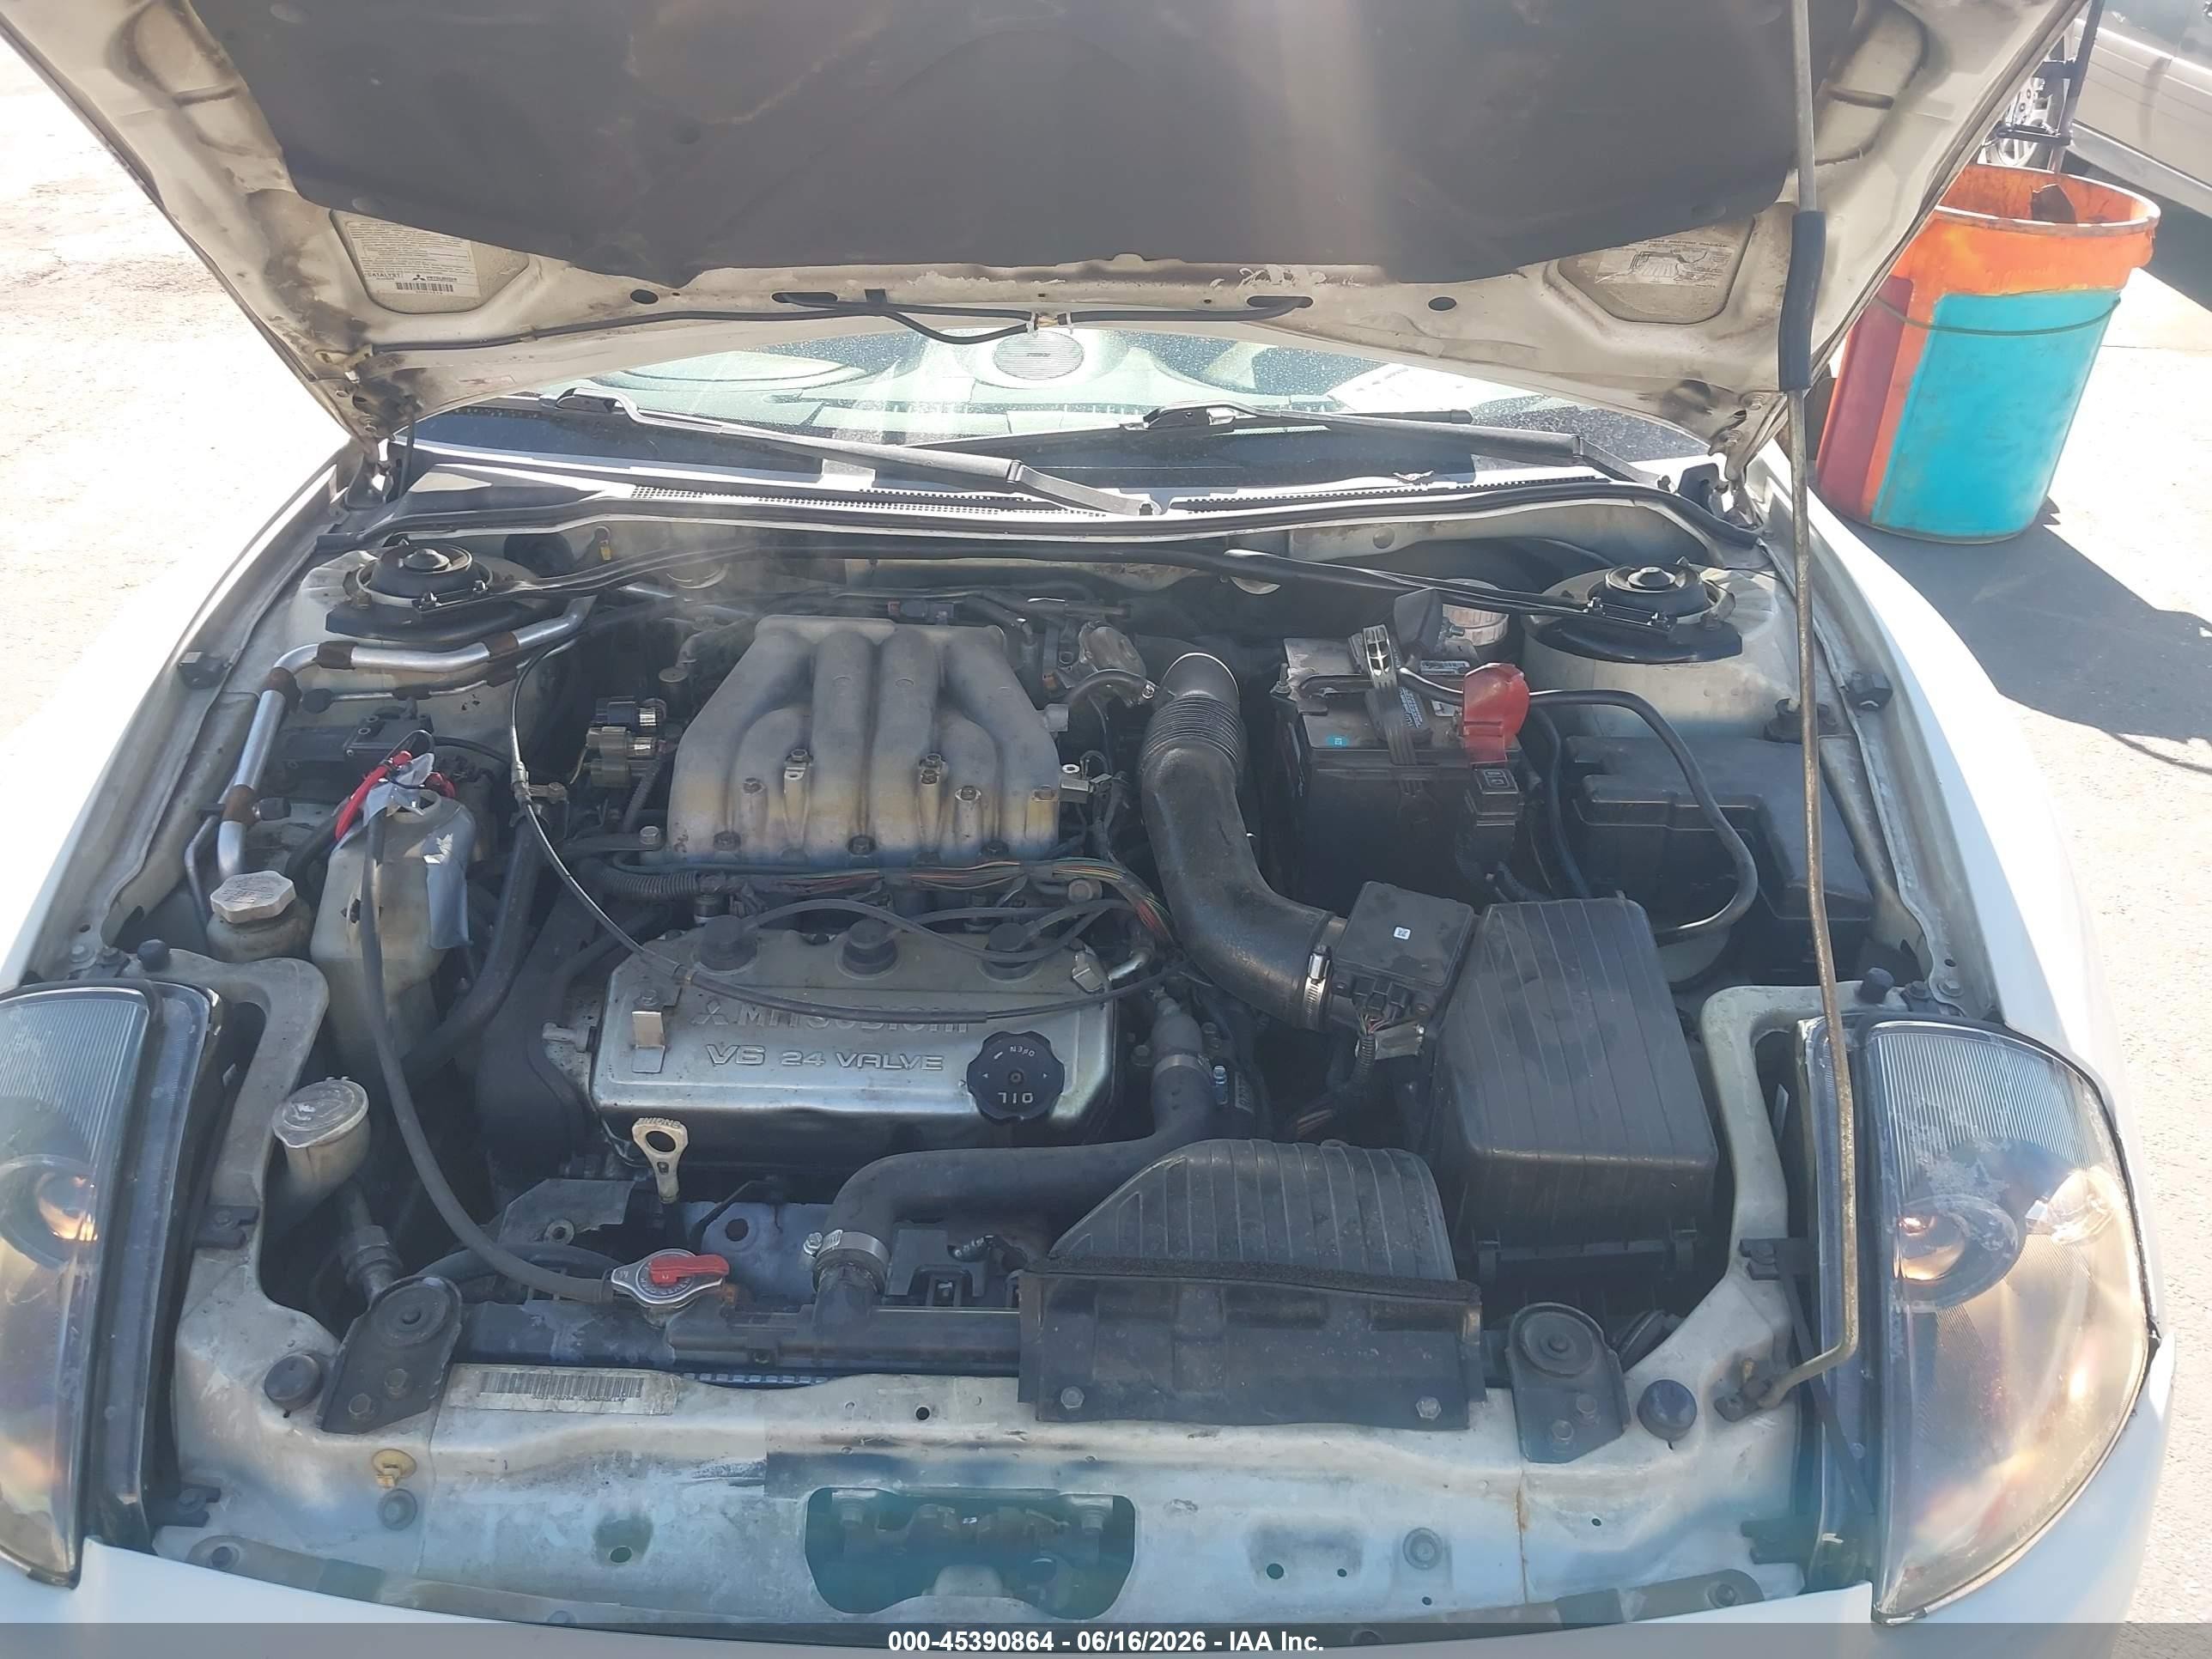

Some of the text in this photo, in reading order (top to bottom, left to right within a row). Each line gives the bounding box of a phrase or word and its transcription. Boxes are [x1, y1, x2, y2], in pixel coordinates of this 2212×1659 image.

[706, 1044, 944, 1071] V6 24 VALVE
[997, 1092, 1034, 1104] OIL
